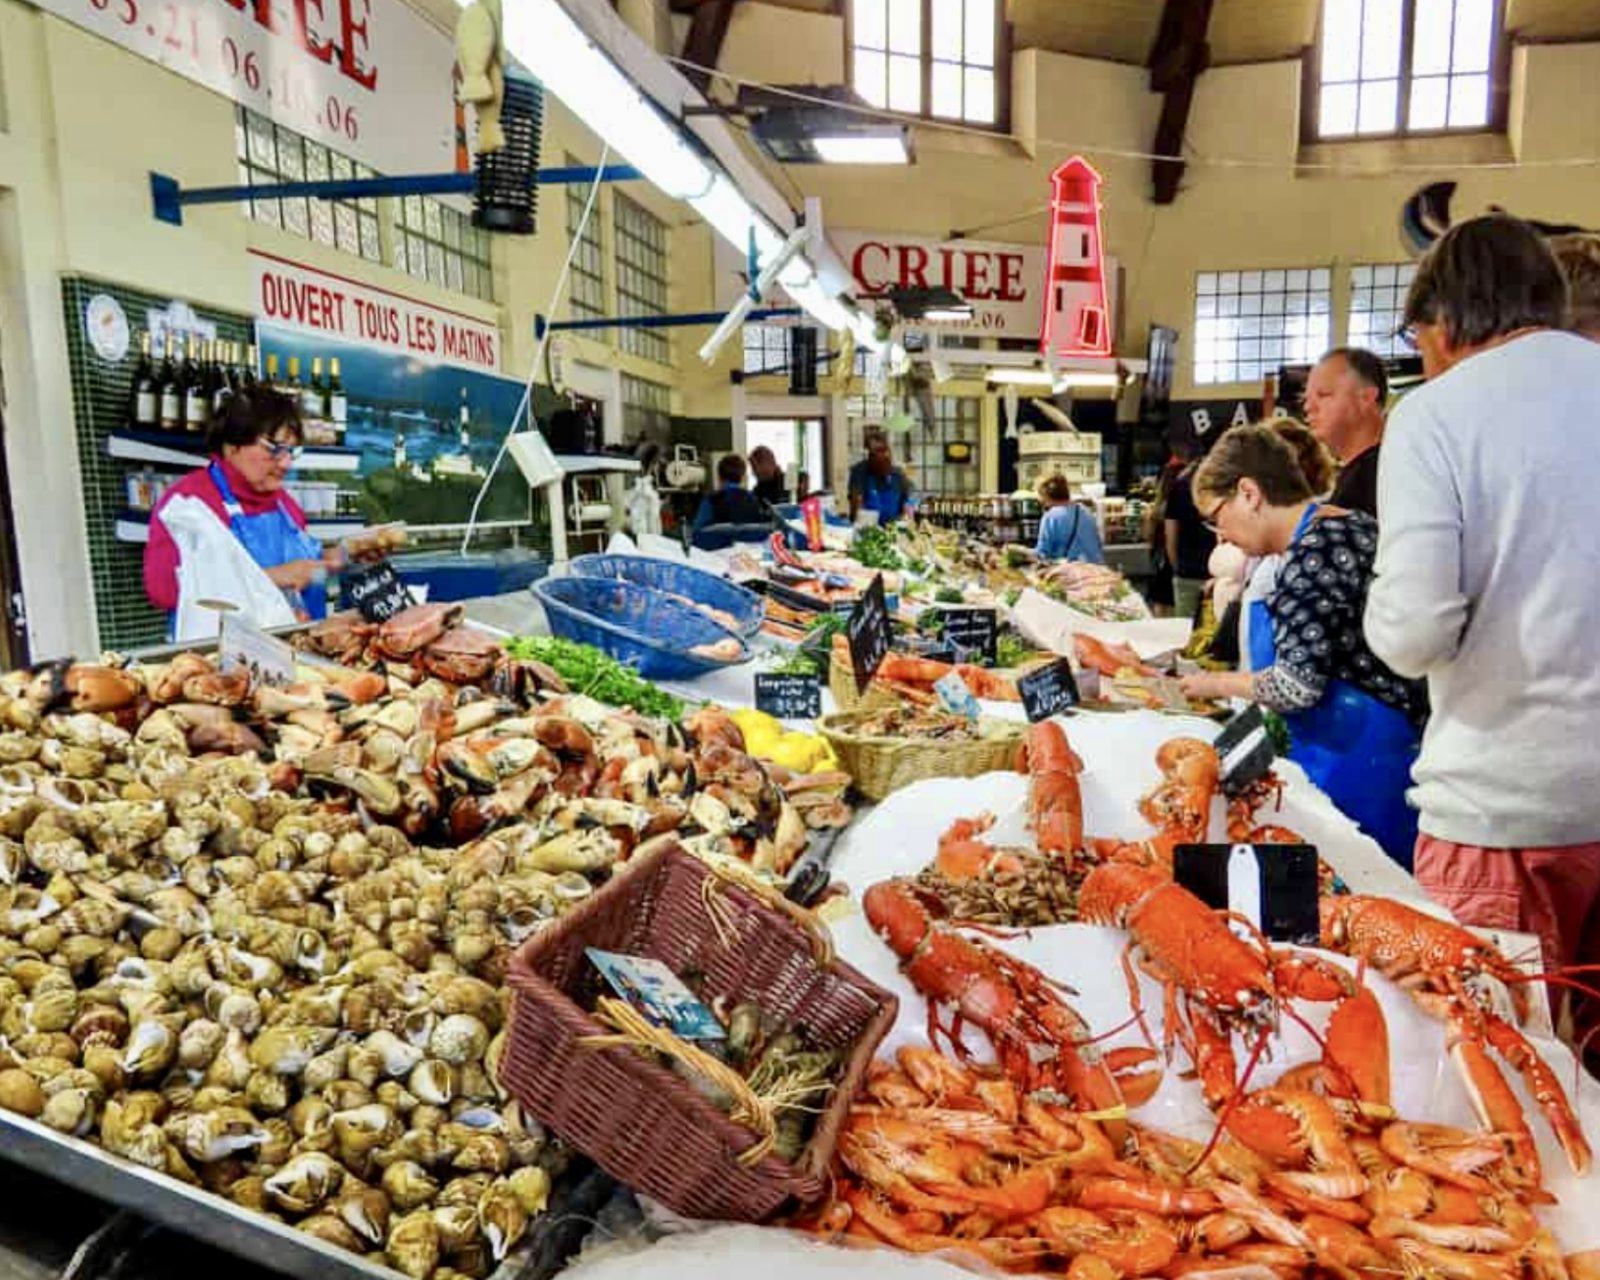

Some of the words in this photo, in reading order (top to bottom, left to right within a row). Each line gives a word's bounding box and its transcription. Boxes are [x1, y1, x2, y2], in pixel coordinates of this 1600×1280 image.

[852, 241, 1027, 302] CRIEE
[261, 272, 345, 332] OUVERT
[354, 299, 399, 344] TOUS
[407, 313, 436, 353] LES
[443, 323, 494, 366] MATINS
